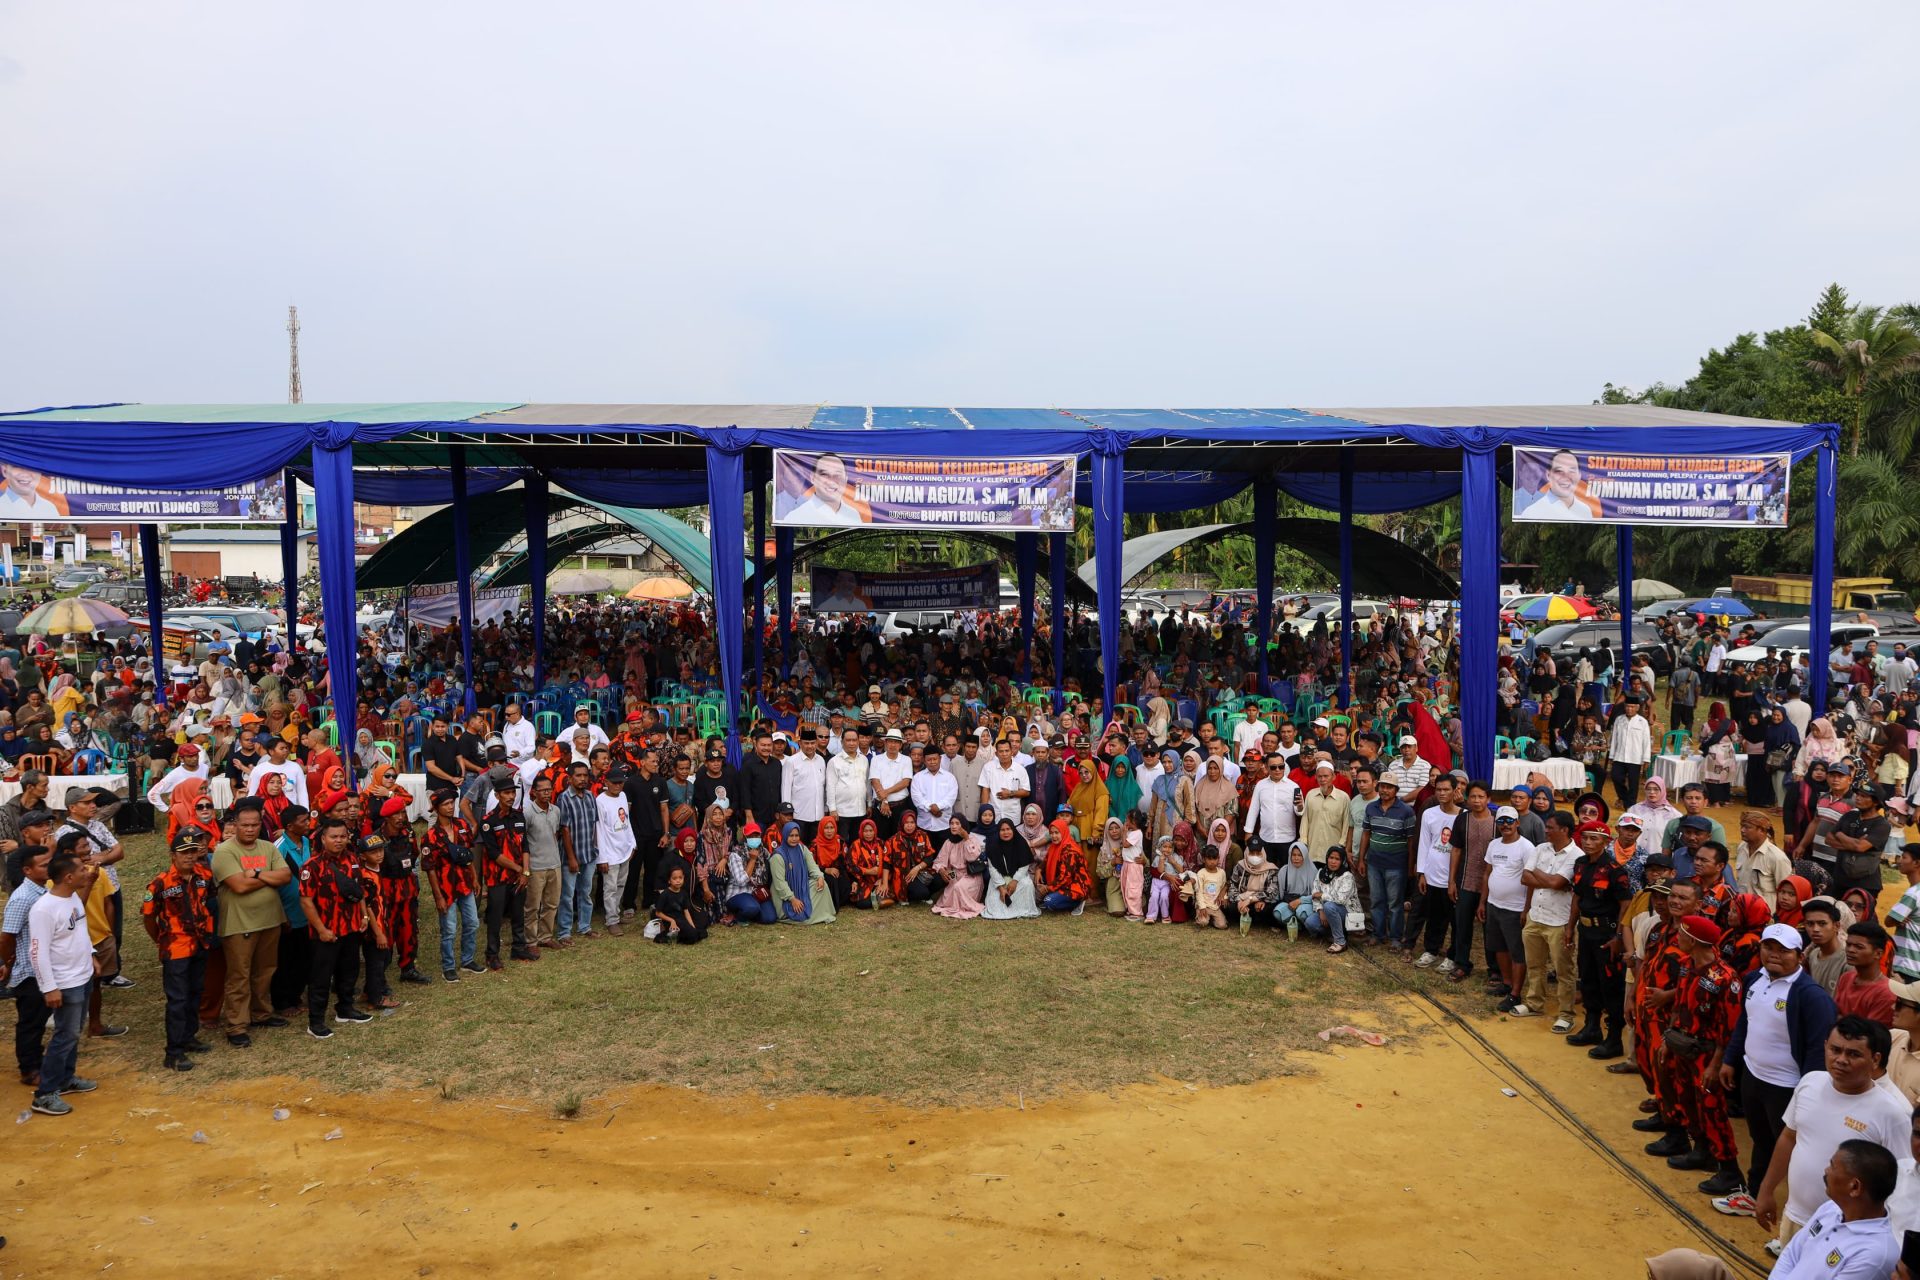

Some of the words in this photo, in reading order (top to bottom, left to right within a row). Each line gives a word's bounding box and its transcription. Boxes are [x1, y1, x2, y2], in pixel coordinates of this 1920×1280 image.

[855, 459, 939, 474] SILATURAHMI
[943, 461, 1005, 475] KELUARGA
[1008, 462, 1048, 476] BESAR
[1587, 455, 1665, 471] SILATURAHMI
[1668, 458, 1725, 472] KELUARGA
[1728, 459, 1765, 473] BESAR
[854, 483, 925, 503] JUMIWAN
[927, 486, 979, 506] AGUZA,
[982, 486, 1015, 506] S.M.,
[1018, 487, 1048, 505] M.M
[1585, 480, 1651, 499] JUMIWAN
[1653, 482, 1700, 502] AGUZA,
[1735, 483, 1763, 501] M.M
[86, 502, 120, 512] UNTUK
[120, 501, 160, 514] BUPATI
[162, 501, 201, 514] BUNGO
[1646, 505, 1681, 517] BUPATI
[1682, 506, 1715, 518] BUNGO
[888, 510, 920, 520] UNTUK
[920, 510, 957, 522] BUPATI
[960, 510, 996, 523] BUNGO
